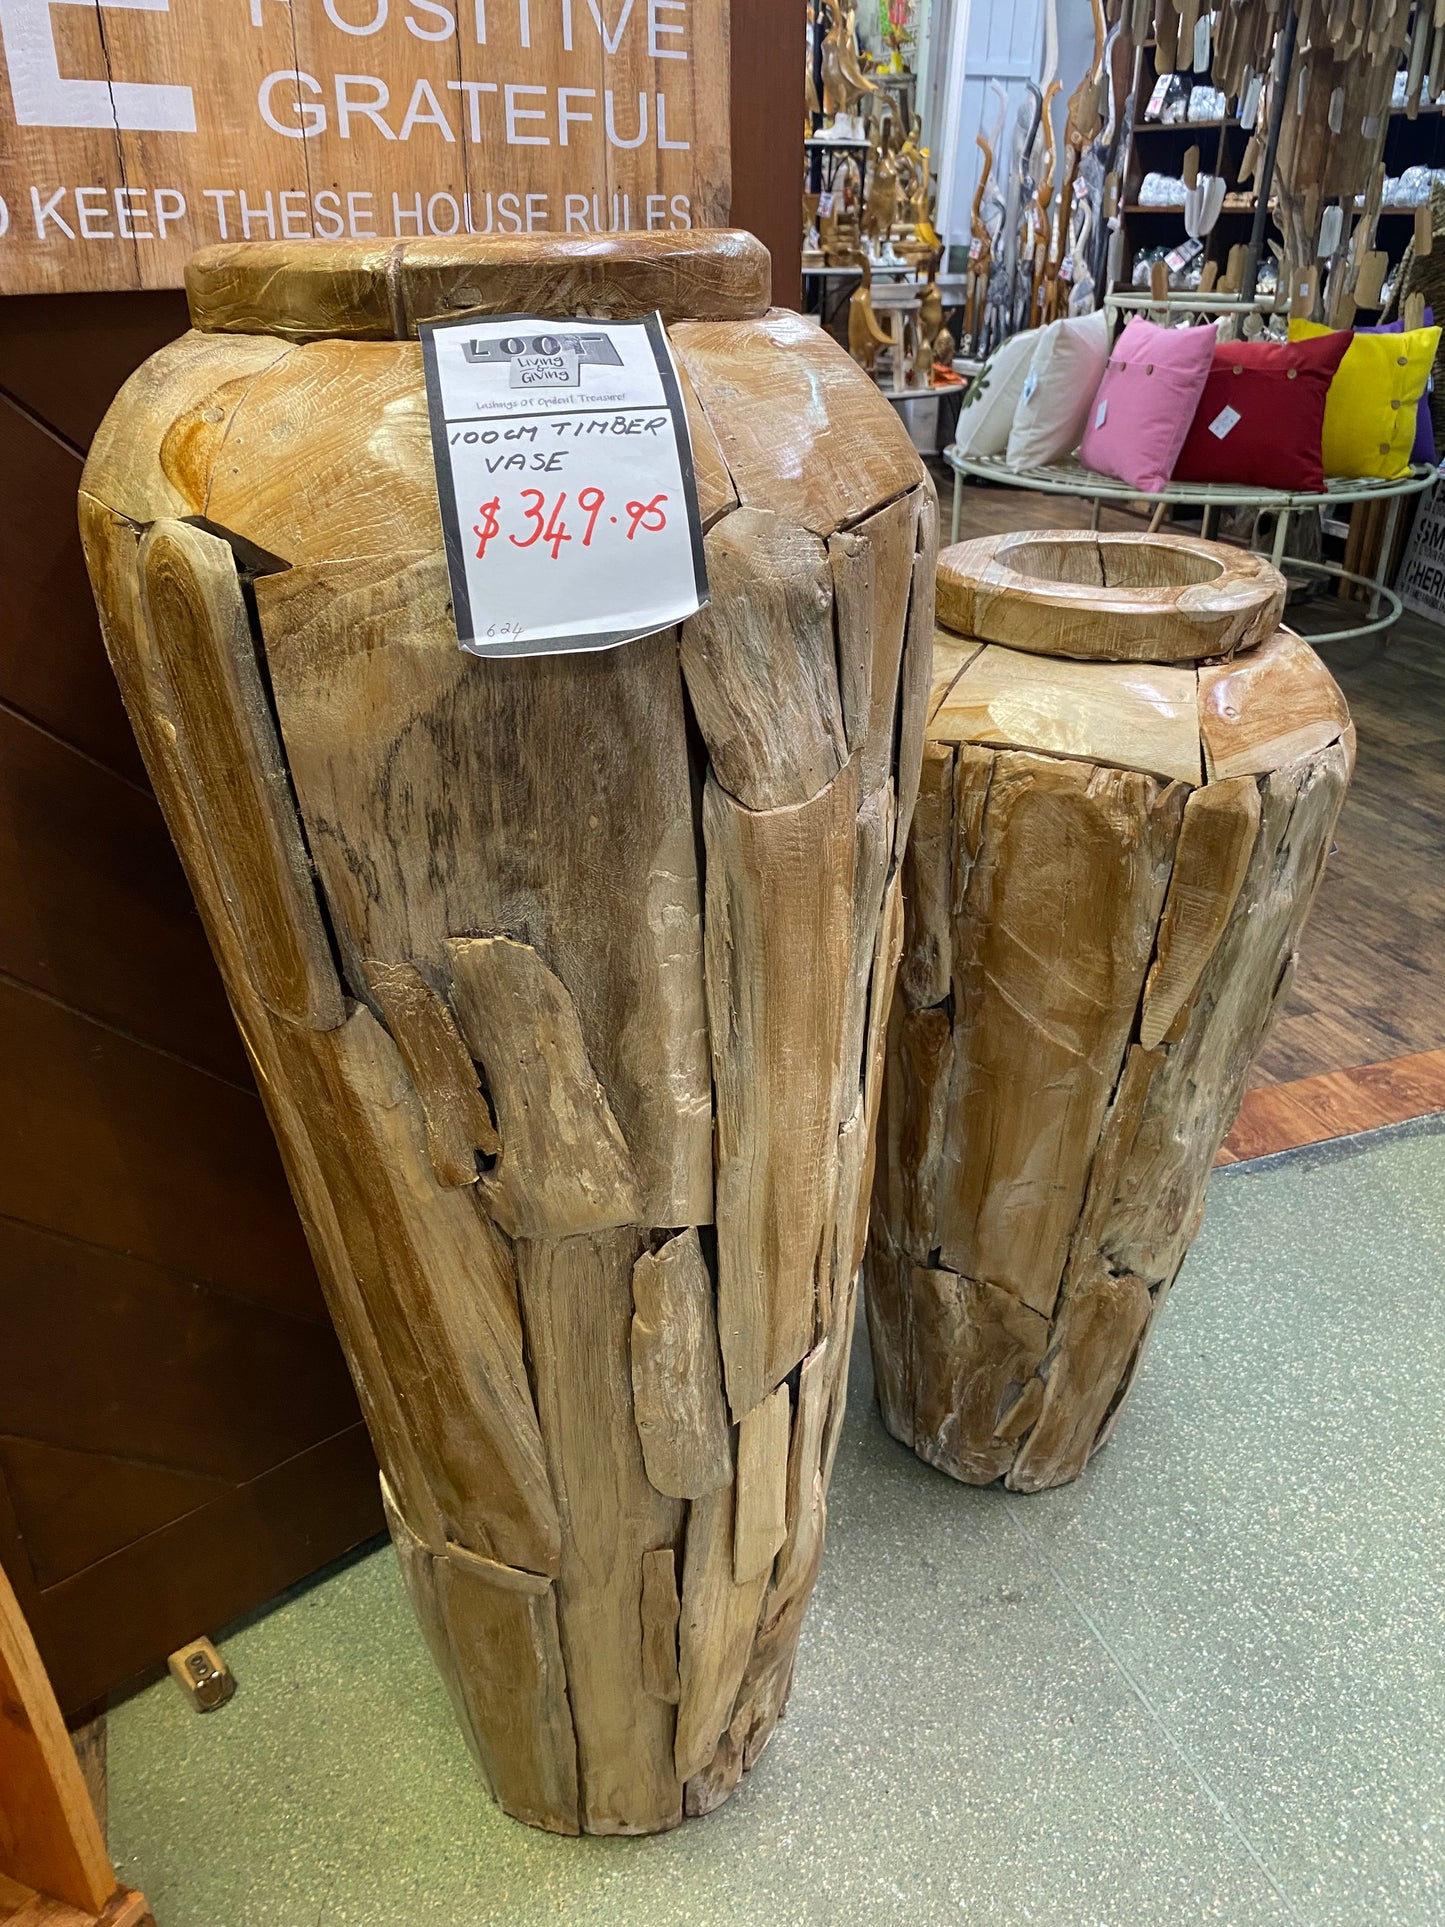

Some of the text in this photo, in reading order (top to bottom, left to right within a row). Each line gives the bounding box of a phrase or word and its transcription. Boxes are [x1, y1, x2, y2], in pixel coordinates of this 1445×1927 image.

[258, 70, 690, 149] GRATEFUL
[30, 186, 187, 240] KEEP
[203, 189, 377, 240] THESE
[392, 192, 548, 237] HOUSE
[564, 194, 692, 233] RULES
[469, 335, 604, 356] LOOT
[551, 415, 668, 437] TIMBER
[485, 450, 570, 474] VASE
[486, 622, 525, 641] 624
